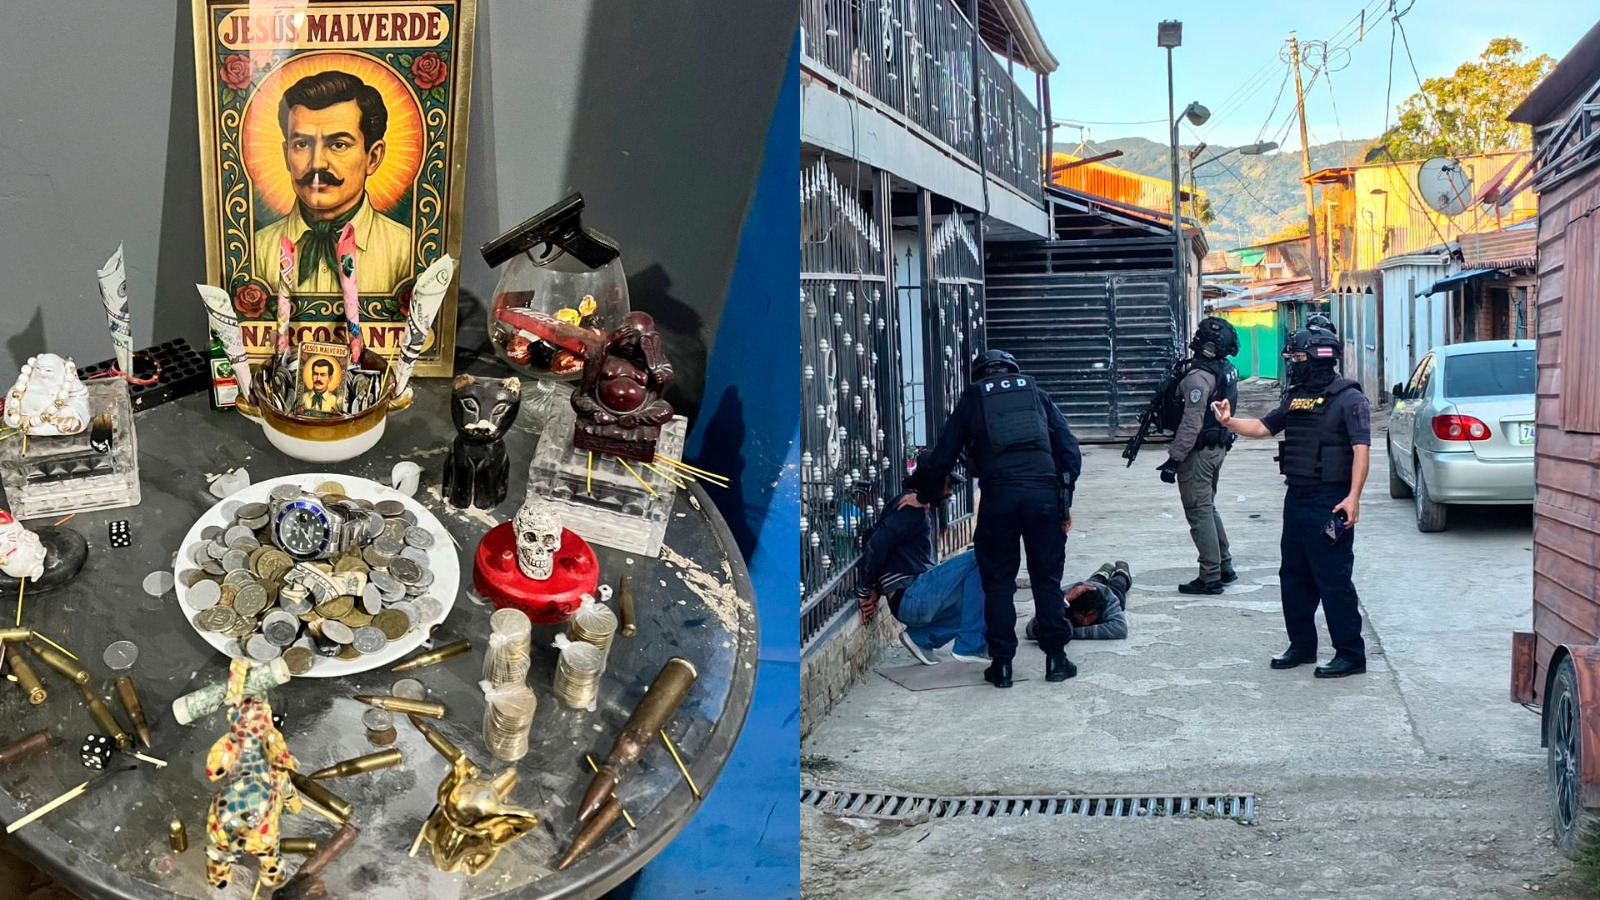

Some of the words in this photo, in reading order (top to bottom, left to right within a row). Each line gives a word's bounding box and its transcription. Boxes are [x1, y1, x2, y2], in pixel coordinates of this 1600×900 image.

[223, 10, 299, 44] JESÚS
[307, 12, 441, 42] MALVERDE
[303, 344, 319, 353] JESÚS
[320, 346, 346, 356] MALVERDE
[985, 379, 1027, 392] PCD
